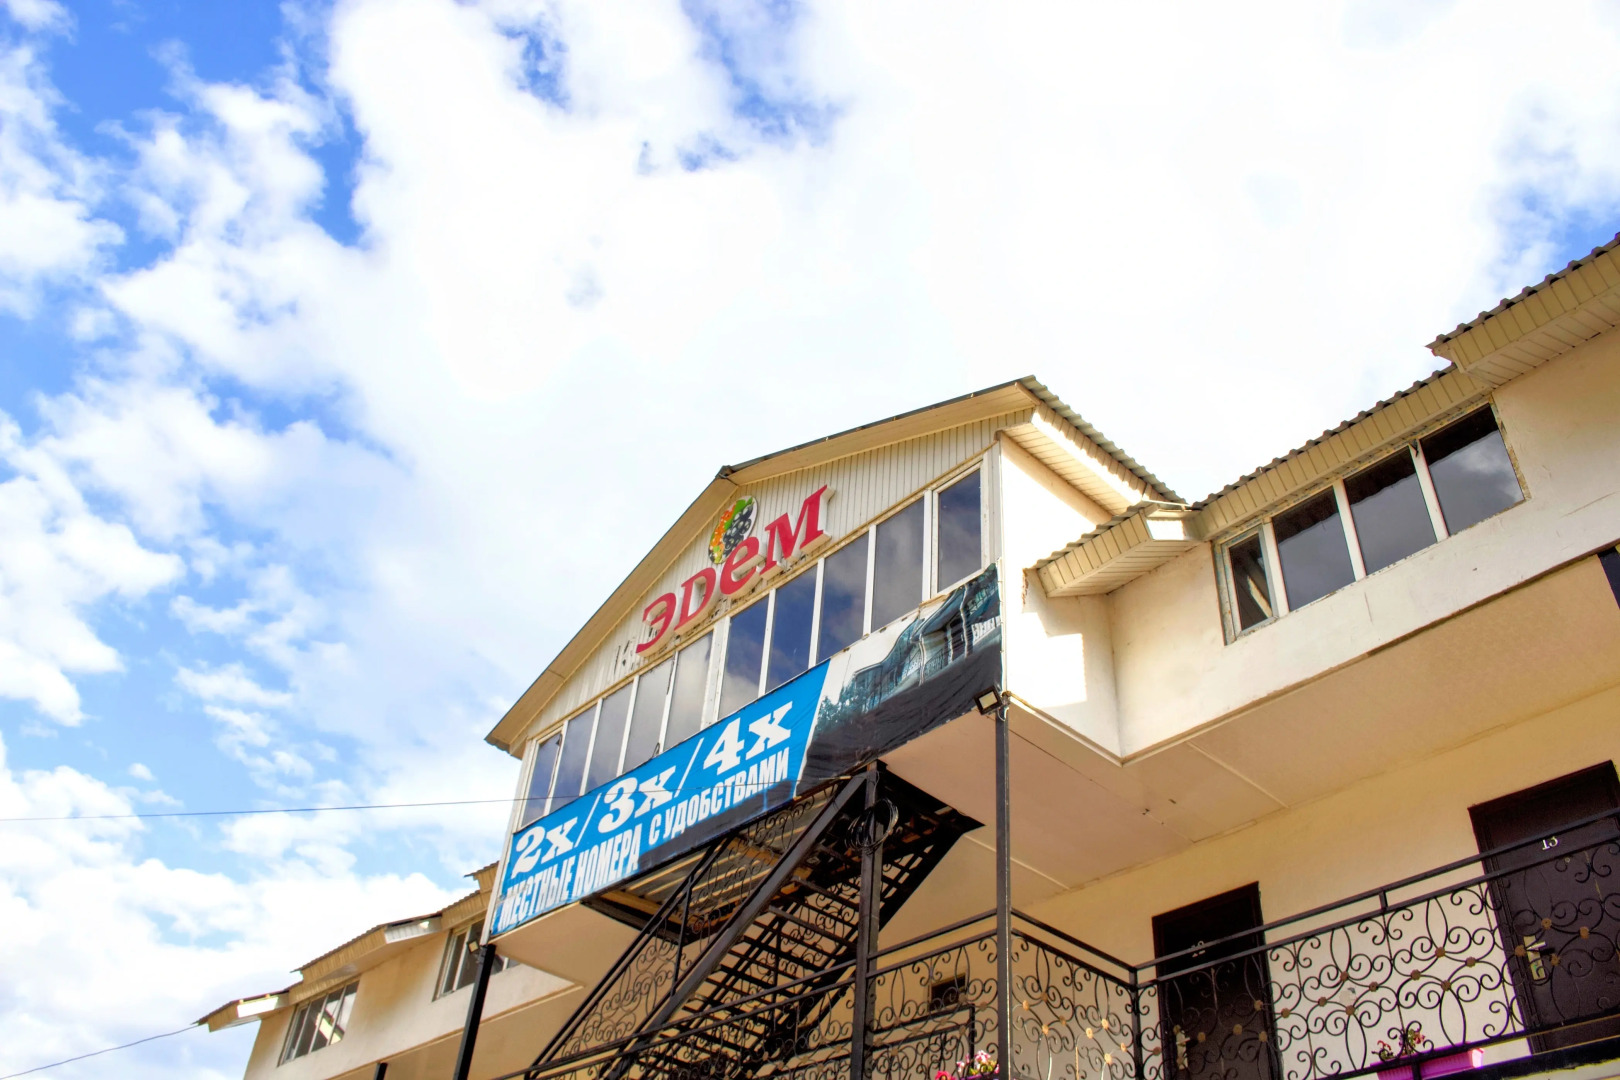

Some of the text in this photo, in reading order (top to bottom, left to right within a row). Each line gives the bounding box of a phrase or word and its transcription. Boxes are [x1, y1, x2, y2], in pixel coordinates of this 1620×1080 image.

[497, 746, 790, 932] МЕСТНЫЕ НОМЕРА С УДОБСТВАМИ
